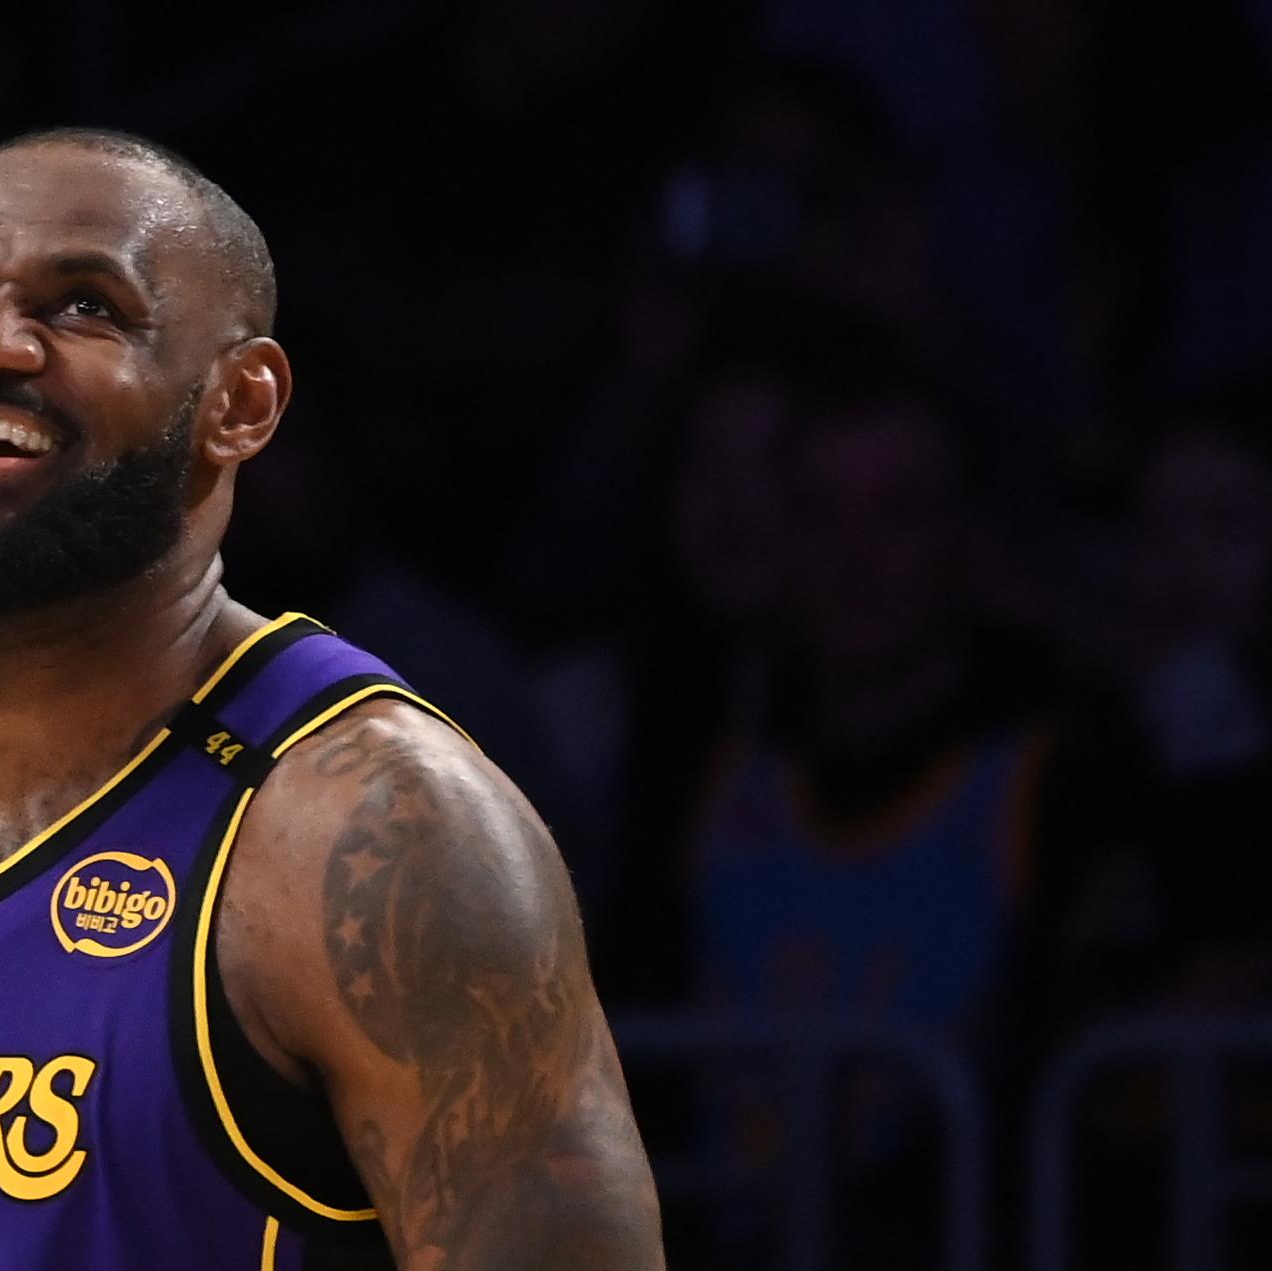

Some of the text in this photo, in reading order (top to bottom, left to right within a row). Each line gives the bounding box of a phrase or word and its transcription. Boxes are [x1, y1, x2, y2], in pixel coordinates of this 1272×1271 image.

[205, 731, 245, 766] 44
[63, 876, 166, 929] bibigo
[76, 913, 118, 934] 비비고
